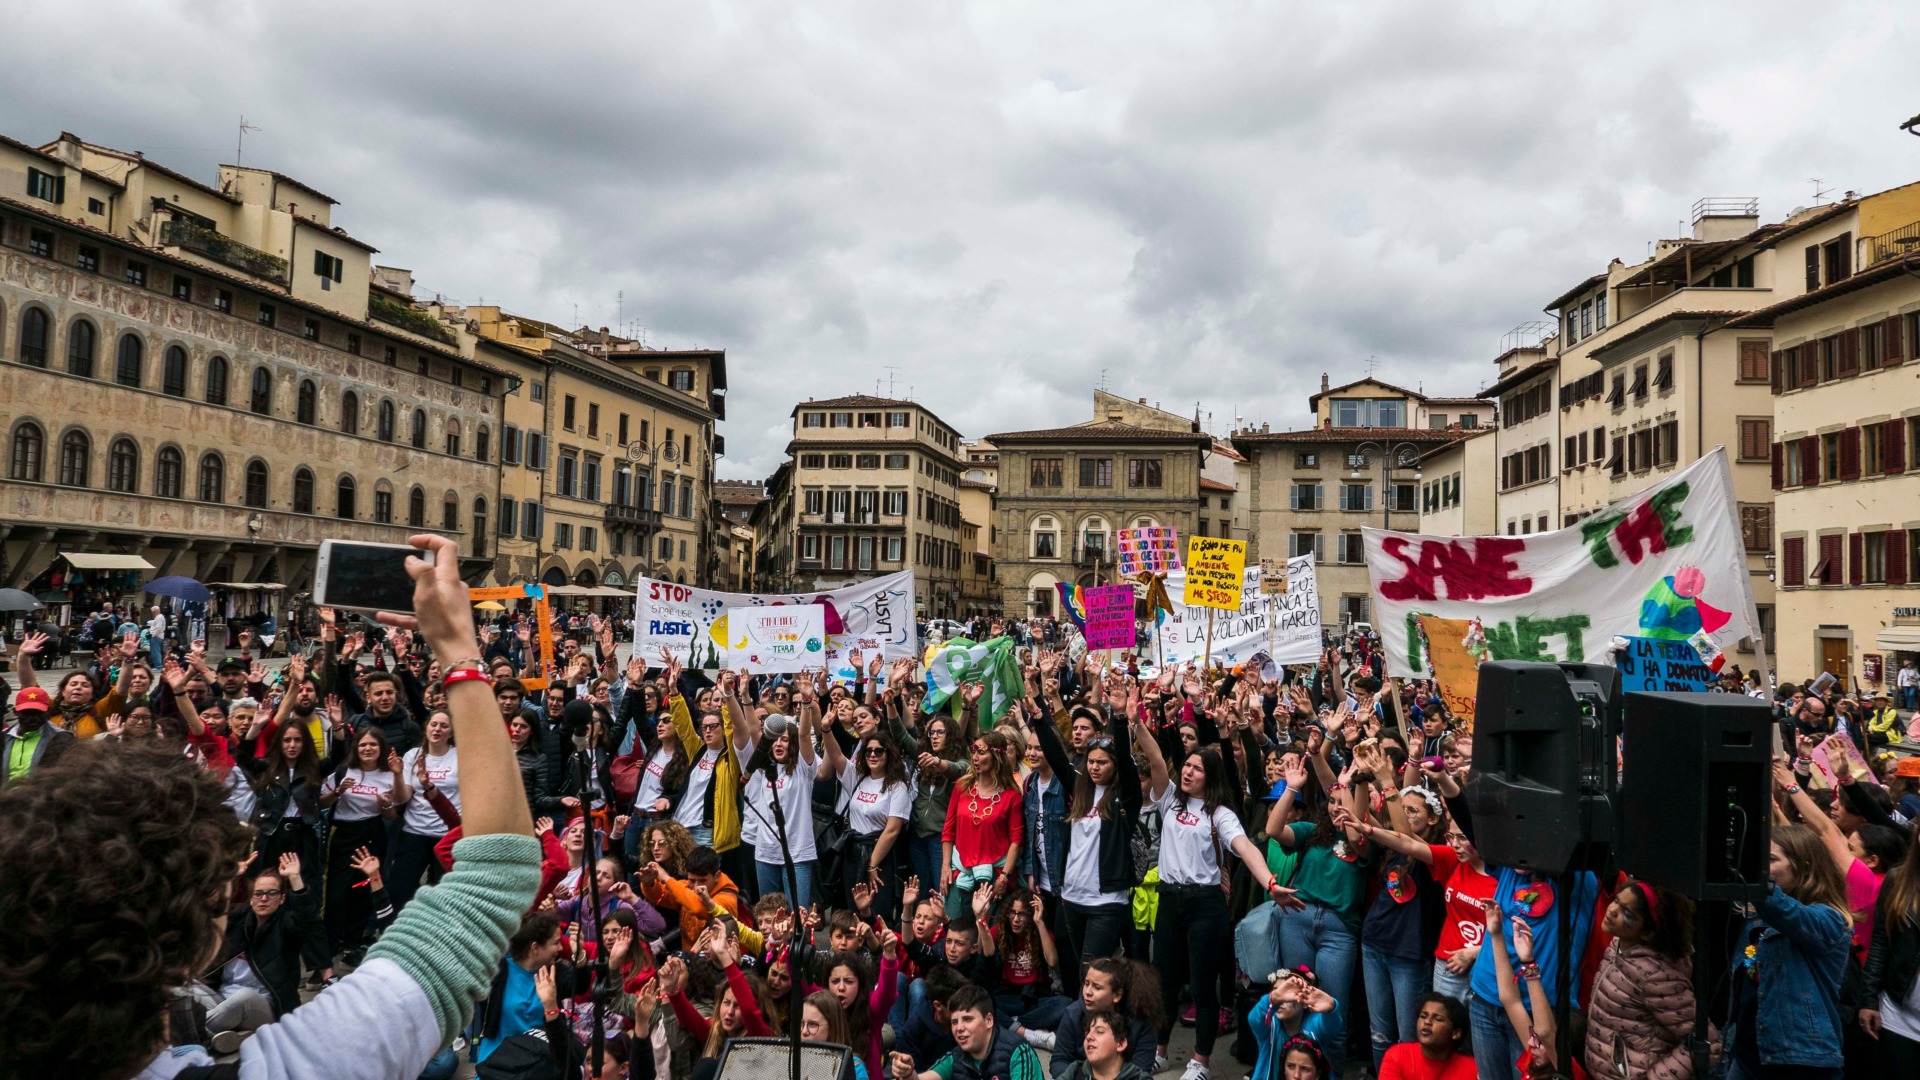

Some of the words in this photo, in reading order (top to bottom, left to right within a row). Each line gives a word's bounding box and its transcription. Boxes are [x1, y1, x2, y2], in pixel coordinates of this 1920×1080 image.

[1580, 480, 1695, 570] THE
[1220, 542, 1230, 551] ME
[649, 583, 692, 602] STOP
[1091, 597, 1099, 607] LA
[1193, 589, 1203, 599] ME
[1206, 589, 1232, 604] STESSO
[1240, 601, 1258, 616] CHE
[1263, 594, 1301, 613] MANCA
[1186, 626, 1205, 643] LA
[1282, 609, 1319, 631] FARLO
[1637, 640, 1654, 658] LA
[1643, 659, 1661, 678] HA
[1666, 661, 1710, 682] DONATO
